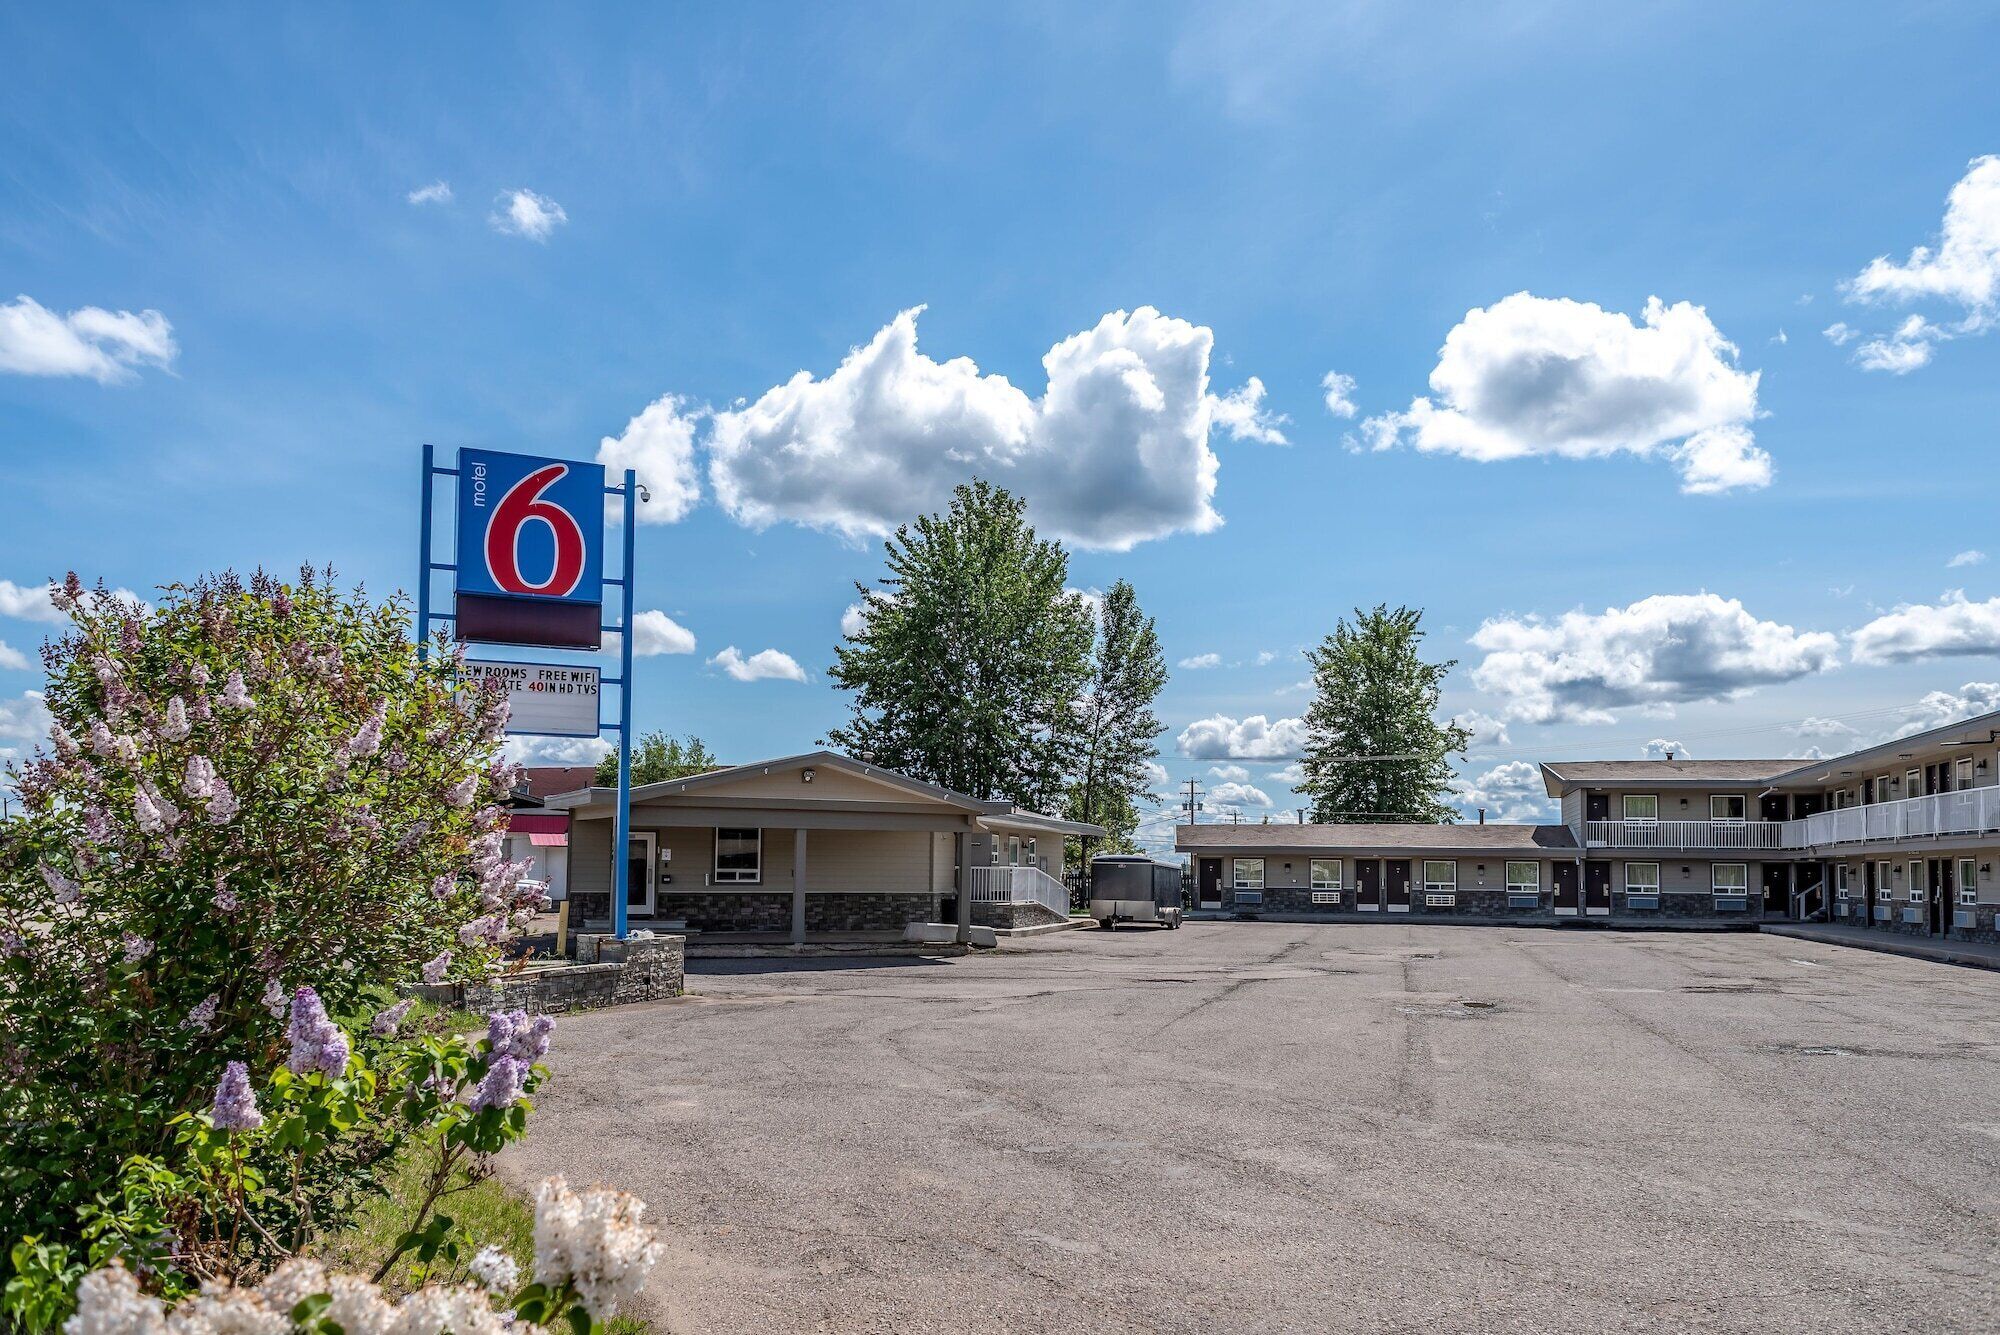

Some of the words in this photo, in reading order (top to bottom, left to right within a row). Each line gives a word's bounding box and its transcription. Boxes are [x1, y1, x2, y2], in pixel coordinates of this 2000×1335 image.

[472, 462, 487, 507] motel
[484, 463, 586, 597] 6
[485, 666, 527, 679] ROOMS
[539, 670, 567, 681] FREE
[571, 671, 595, 683] WIFI
[494, 680, 523, 691] ATE
[559, 683, 574, 694] HD
[577, 684, 597, 695] TVS
